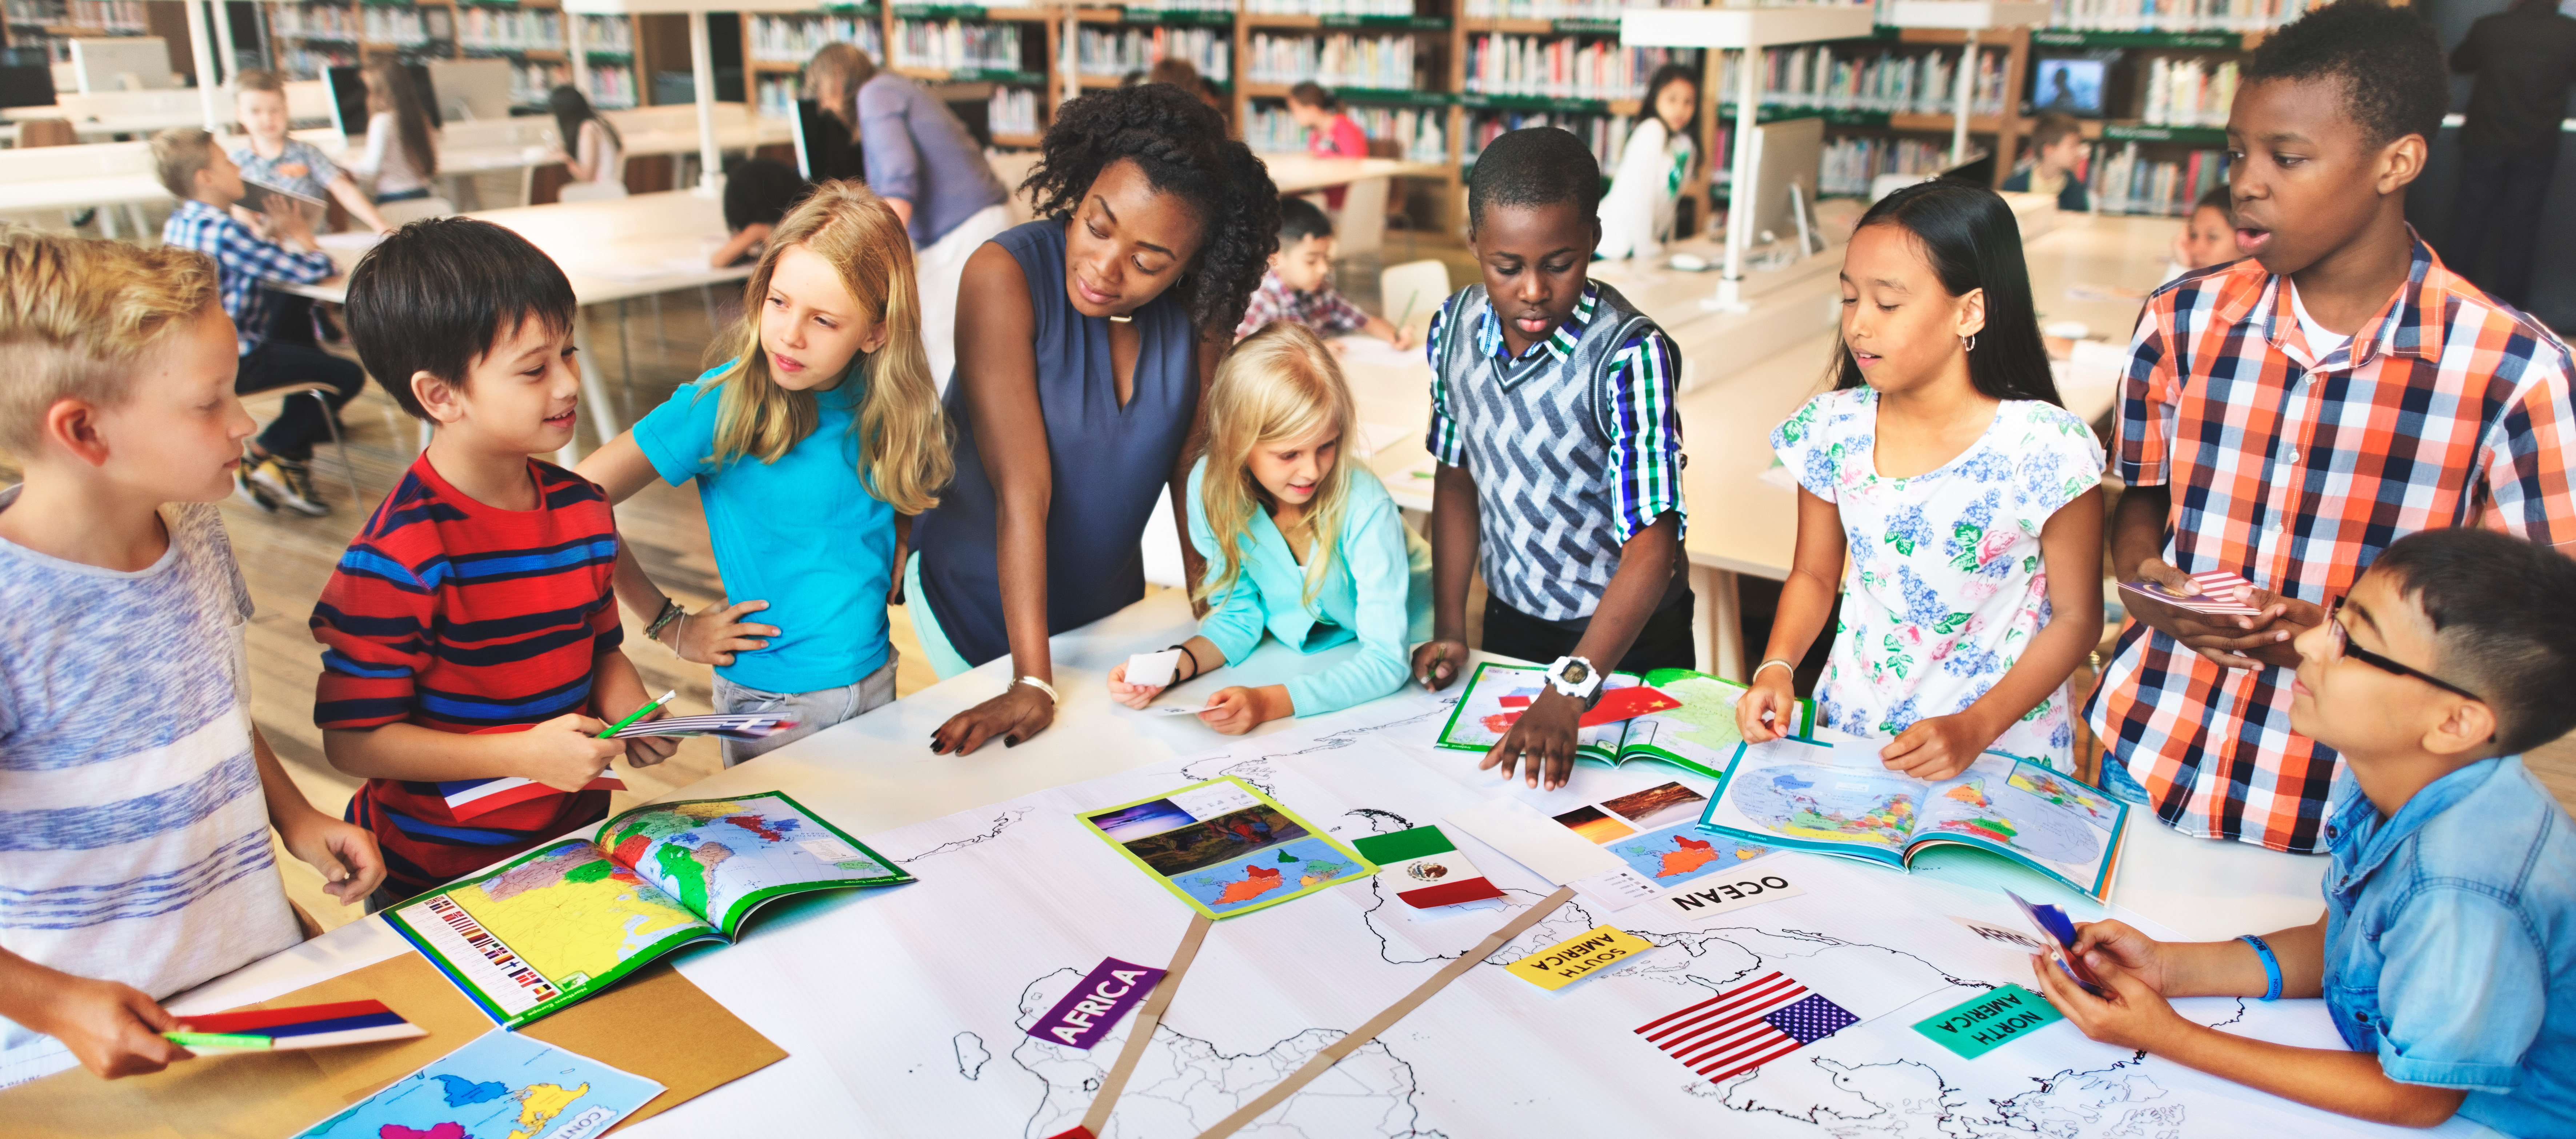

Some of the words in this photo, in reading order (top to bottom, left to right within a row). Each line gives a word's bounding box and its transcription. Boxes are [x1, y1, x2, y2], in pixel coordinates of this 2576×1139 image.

[1716, 827, 1744, 836] Countries
[2028, 861, 2058, 878] Countries
[1672, 877, 1788, 911] OCEAN
[2061, 878, 2080, 891] World
[1967, 925, 2041, 948] AFRIC
[1530, 933, 1615, 970] AMERICA
[1558, 949, 1626, 978] SOUTH
[555, 987, 588, 1003] Northern
[527, 1003, 554, 1016] Europe
[1051, 970, 1147, 1044] AFRICA
[1936, 993, 2023, 1033] AMERICA
[1971, 1011, 2044, 1045] NORTH
[523, 1056, 538, 1066] Ocean
[384, 1096, 401, 1106] Ocean
[554, 1112, 601, 1139] CONT
